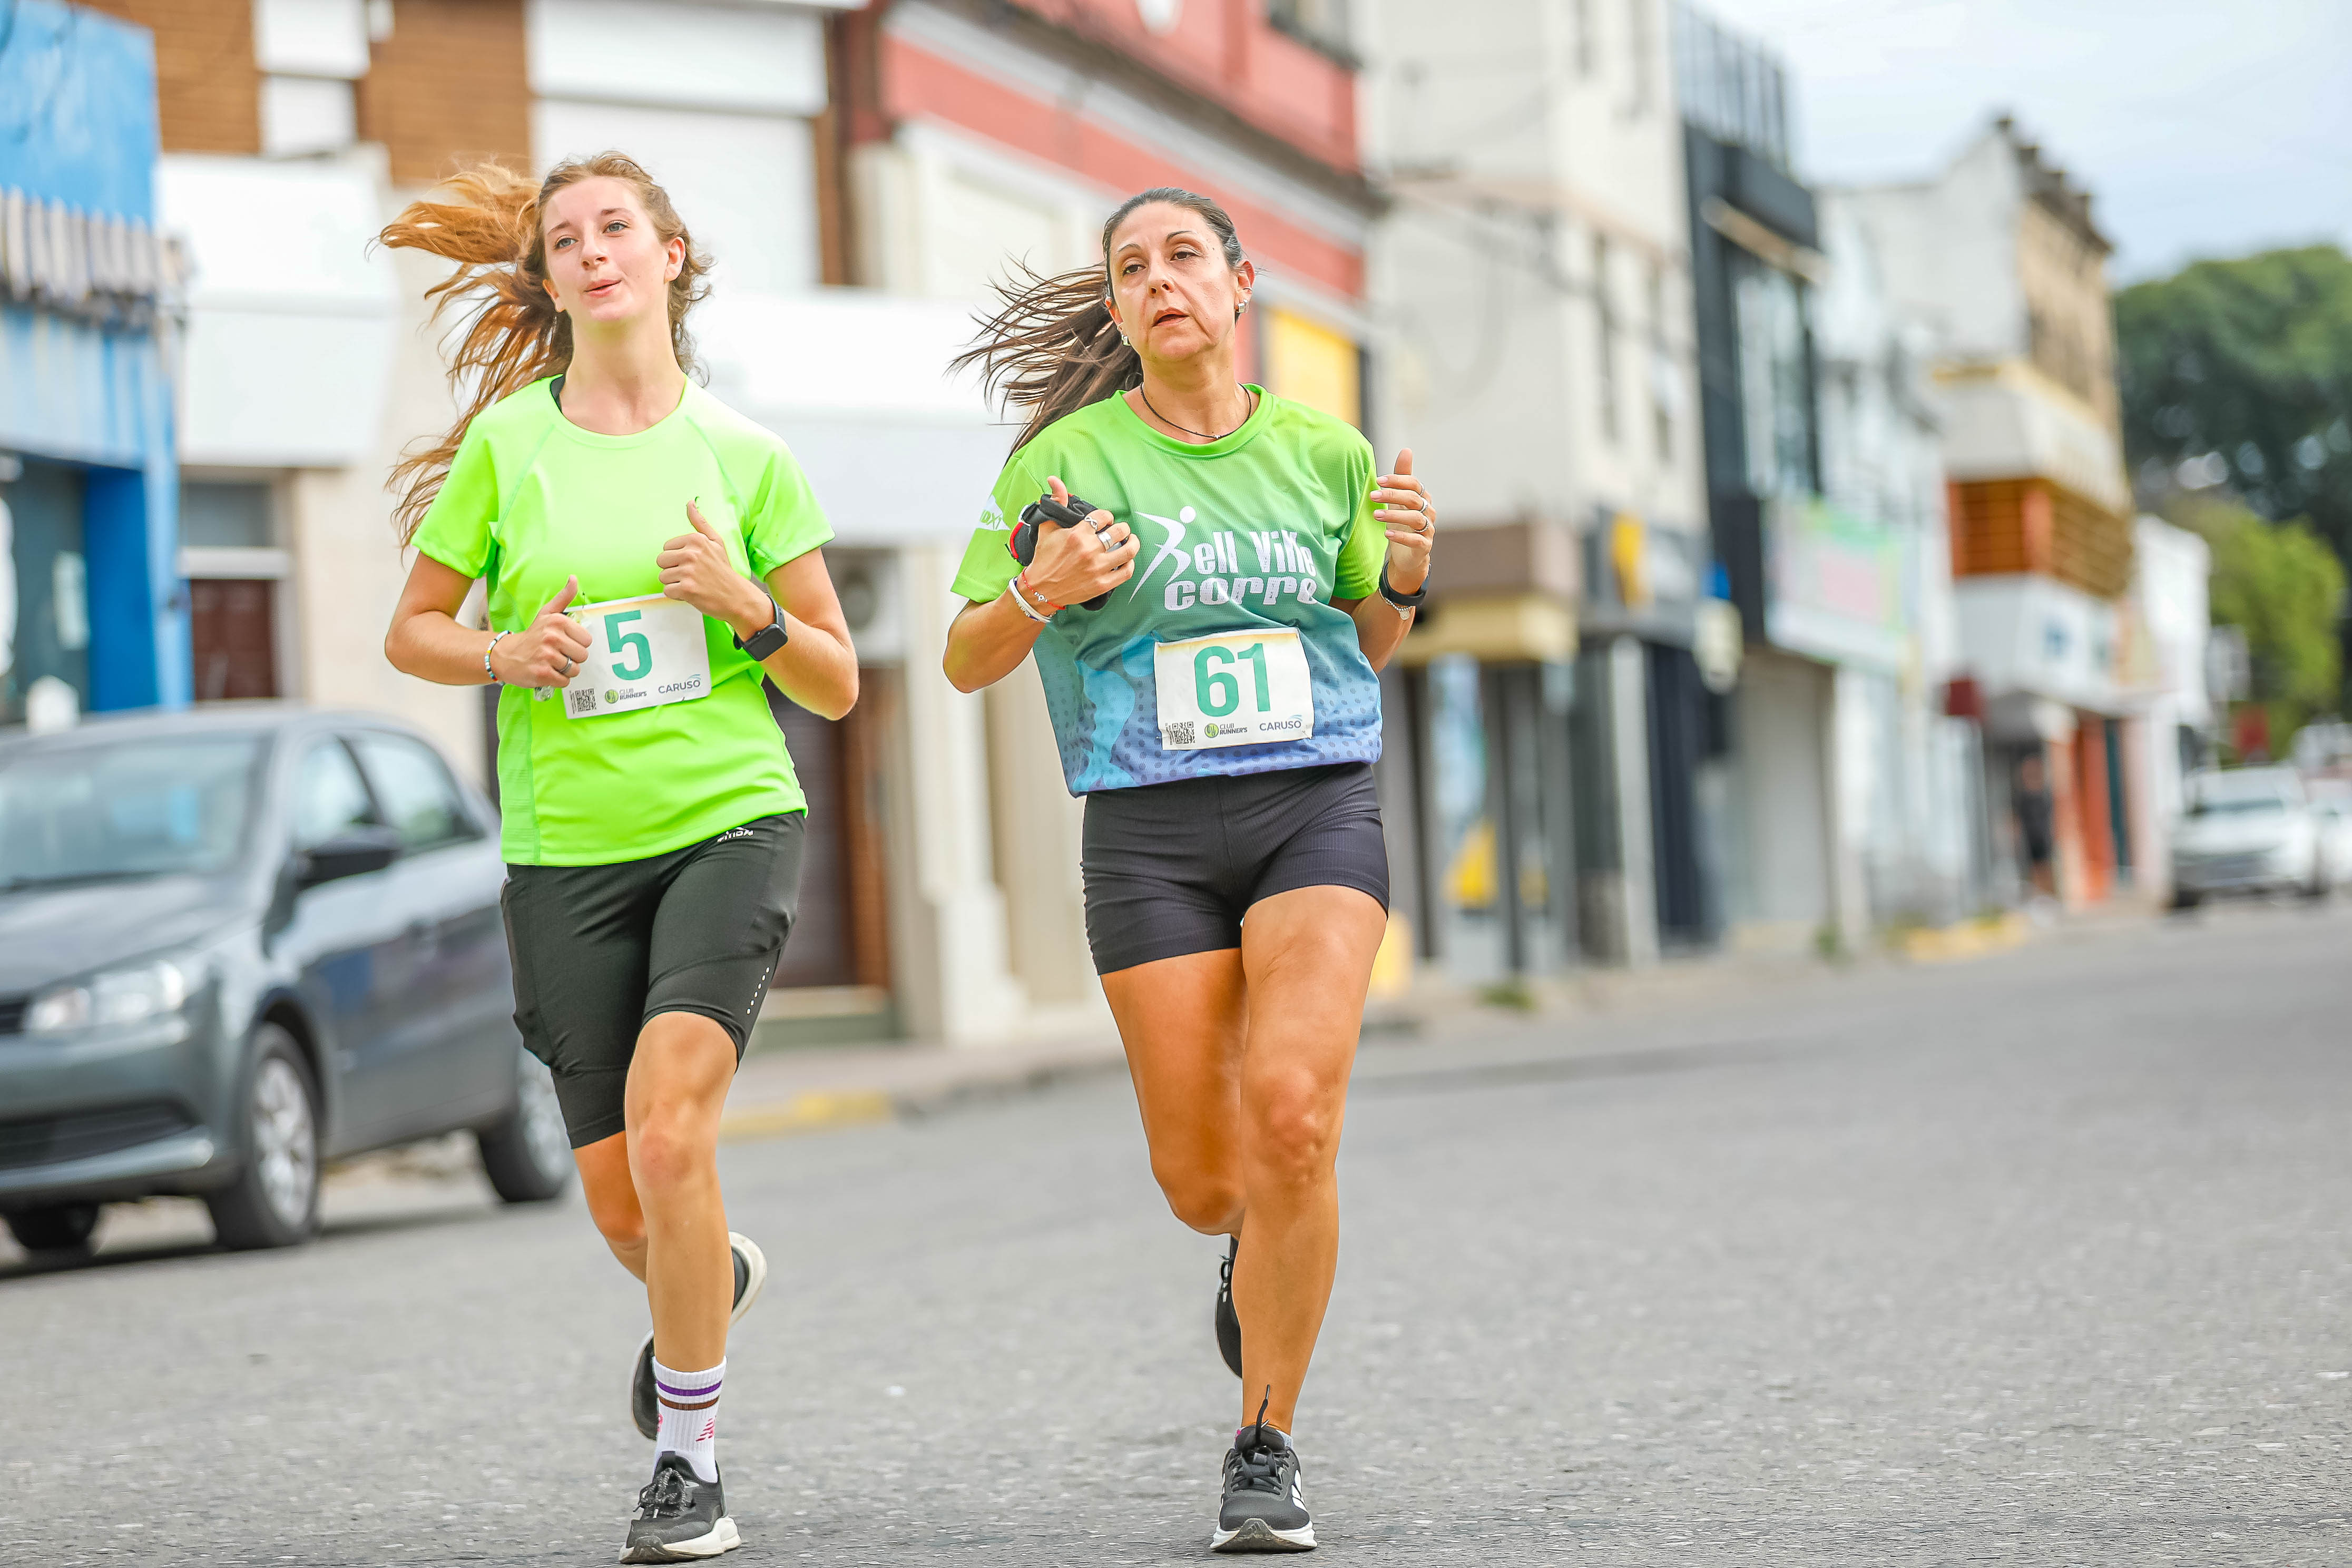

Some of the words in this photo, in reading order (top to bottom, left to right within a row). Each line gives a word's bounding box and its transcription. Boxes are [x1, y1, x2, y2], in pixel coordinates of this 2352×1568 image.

[1164, 575, 1317, 611] corre
[604, 610, 652, 680] 5
[658, 680, 701, 693] CARUSO
[1194, 643, 1270, 717] 61
[1259, 720, 1301, 731] CARUSO
